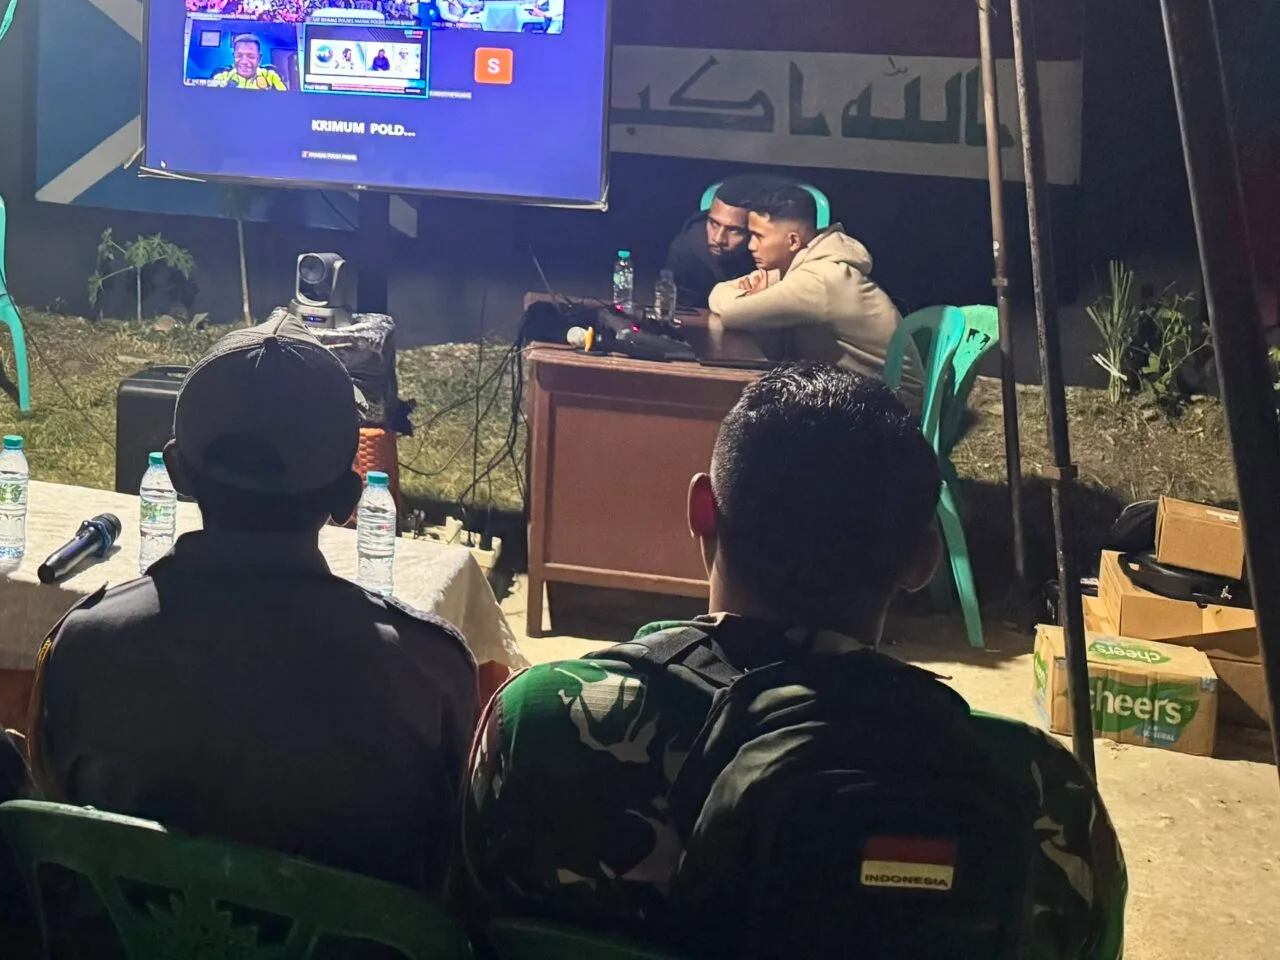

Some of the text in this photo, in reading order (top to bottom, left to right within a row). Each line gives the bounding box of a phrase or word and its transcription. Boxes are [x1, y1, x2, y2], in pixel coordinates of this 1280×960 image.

[487, 57, 501, 74] S
[311, 119, 417, 137] KRIMUM POLD...
[1094, 642, 1162, 664] cheers
[864, 873, 949, 888] INDONESIA
